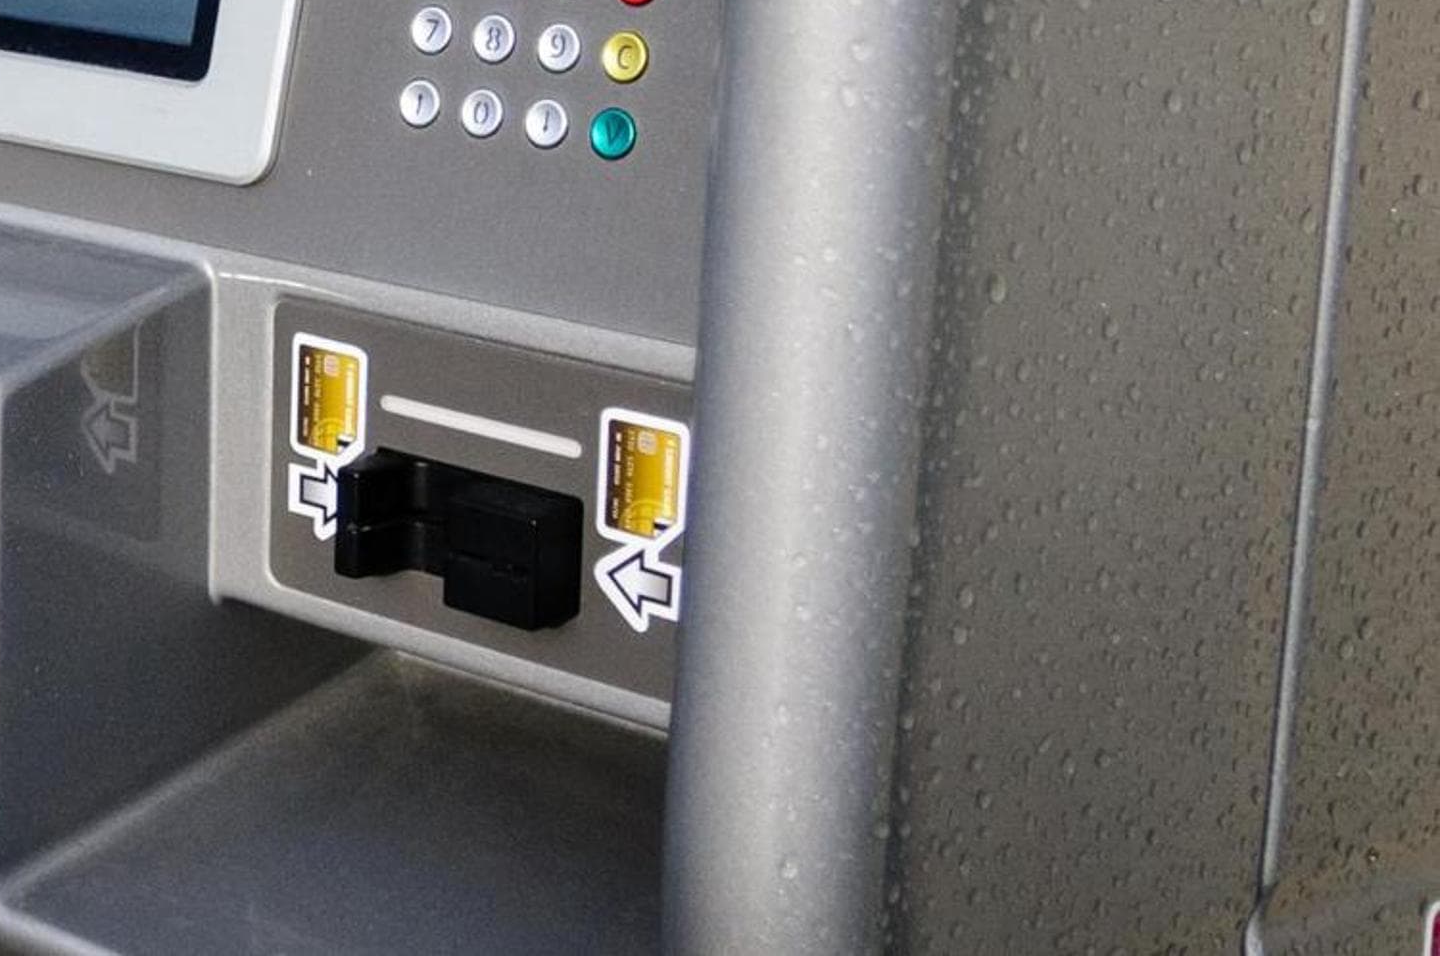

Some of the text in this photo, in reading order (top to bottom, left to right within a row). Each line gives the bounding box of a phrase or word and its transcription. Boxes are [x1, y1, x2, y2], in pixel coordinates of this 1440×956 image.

[425, 18, 632, 70] 7 8 9 C
[473, 99, 490, 125] 0
